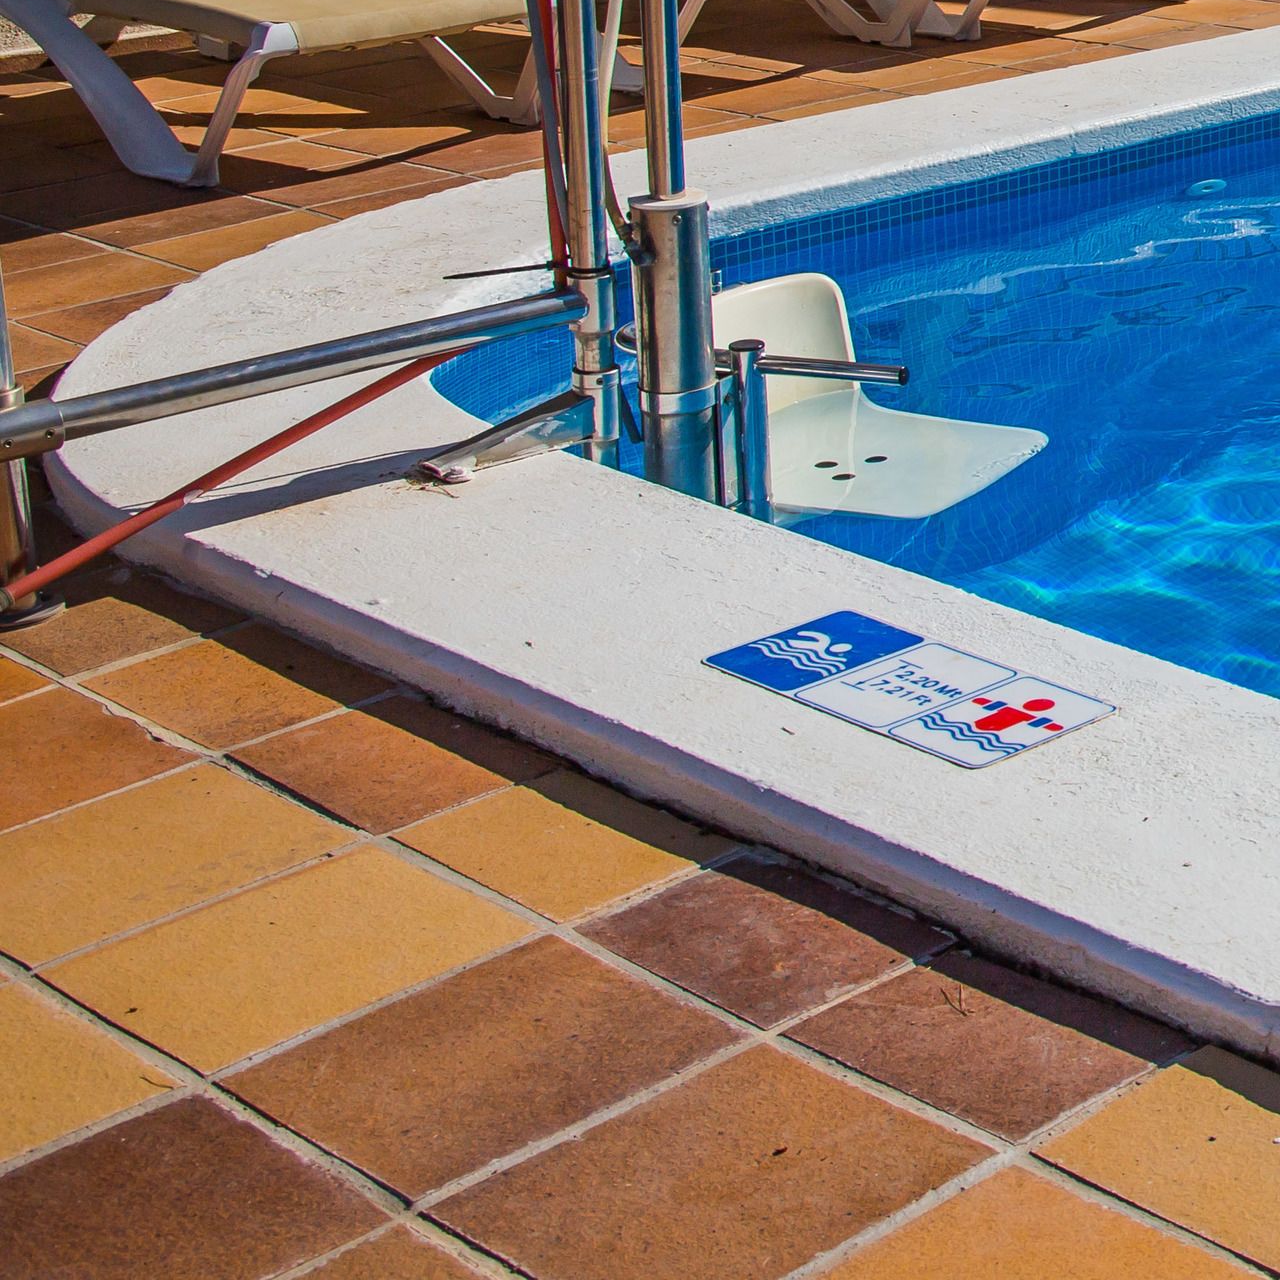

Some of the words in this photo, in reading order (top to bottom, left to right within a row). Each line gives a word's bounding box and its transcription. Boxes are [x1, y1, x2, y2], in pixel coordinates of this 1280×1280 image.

[869, 679, 915, 698] 7,21
[907, 694, 932, 706] Ft
[895, 670, 940, 688] 2,20
[933, 684, 963, 698] Mt
